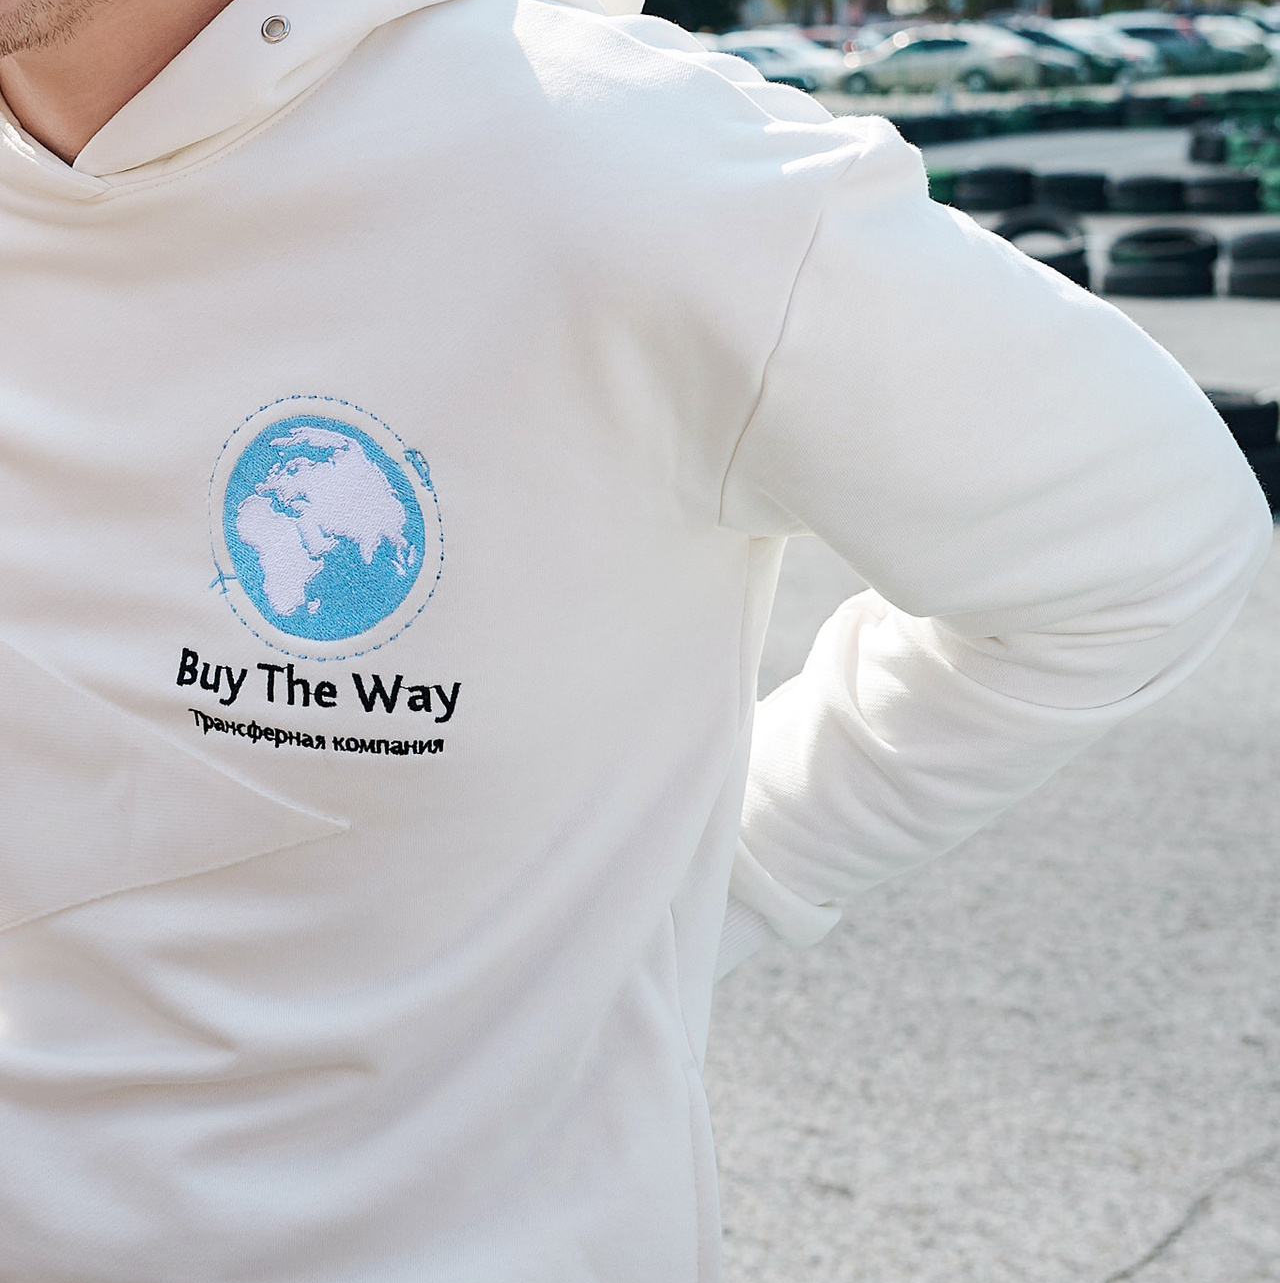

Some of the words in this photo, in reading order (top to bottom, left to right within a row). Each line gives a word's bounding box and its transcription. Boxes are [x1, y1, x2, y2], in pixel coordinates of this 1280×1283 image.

[176, 647, 248, 707] Buy
[257, 663, 338, 708] The
[352, 672, 462, 724] Way
[188, 708, 326, 749] Трансферная
[332, 735, 445, 756] компания
